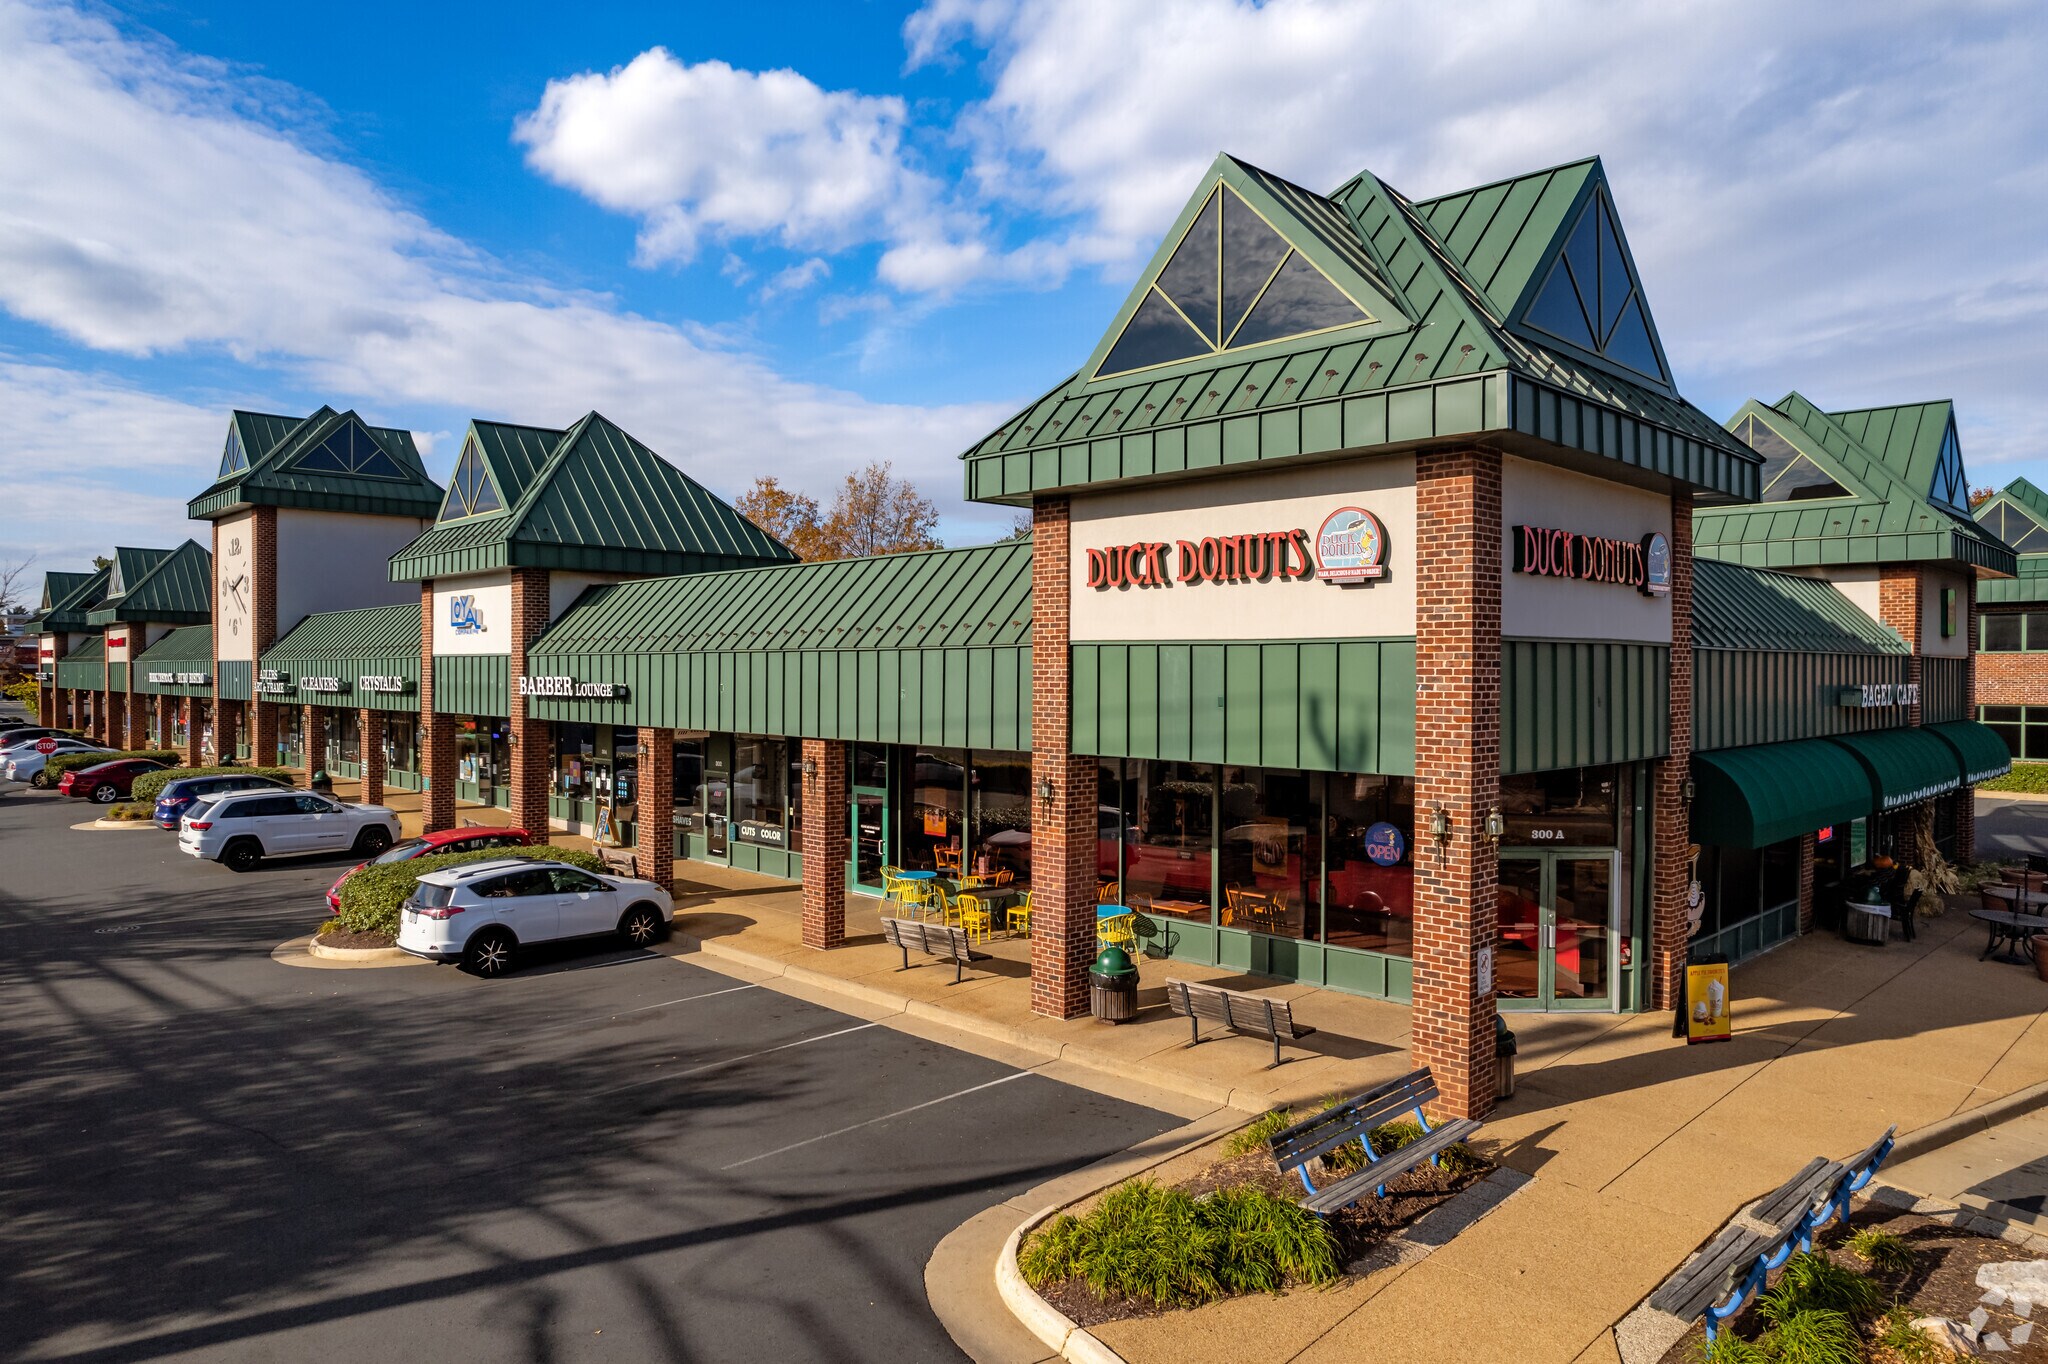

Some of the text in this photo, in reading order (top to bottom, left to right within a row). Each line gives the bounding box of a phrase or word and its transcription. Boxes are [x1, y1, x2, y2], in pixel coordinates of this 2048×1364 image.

[230, 537, 240, 556] 12
[1323, 533, 1356, 545] DUCK
[1321, 542, 1363, 557] DONUTS
[1523, 525, 1644, 586] DUCK DONUTS
[1086, 528, 1307, 588] DUCK DONUTS
[222, 580, 228, 597] 9
[244, 576, 249, 594] 3
[232, 618, 238, 636] 6
[259, 669, 278, 680] ADLERS
[254, 681, 262, 692] ART
[267, 682, 285, 693] FRAME
[301, 677, 339, 692] CLEANERS
[360, 676, 402, 692] CRYSTALIS
[519, 676, 613, 697] BARBER LOUNGE
[1861, 683, 1919, 707] BAGEL CAFE
[672, 815, 692, 826] SHAVES
[741, 826, 781, 841] CUTS COLOR
[1531, 829, 1565, 839] 300 A
[1367, 843, 1401, 861] OPEN
